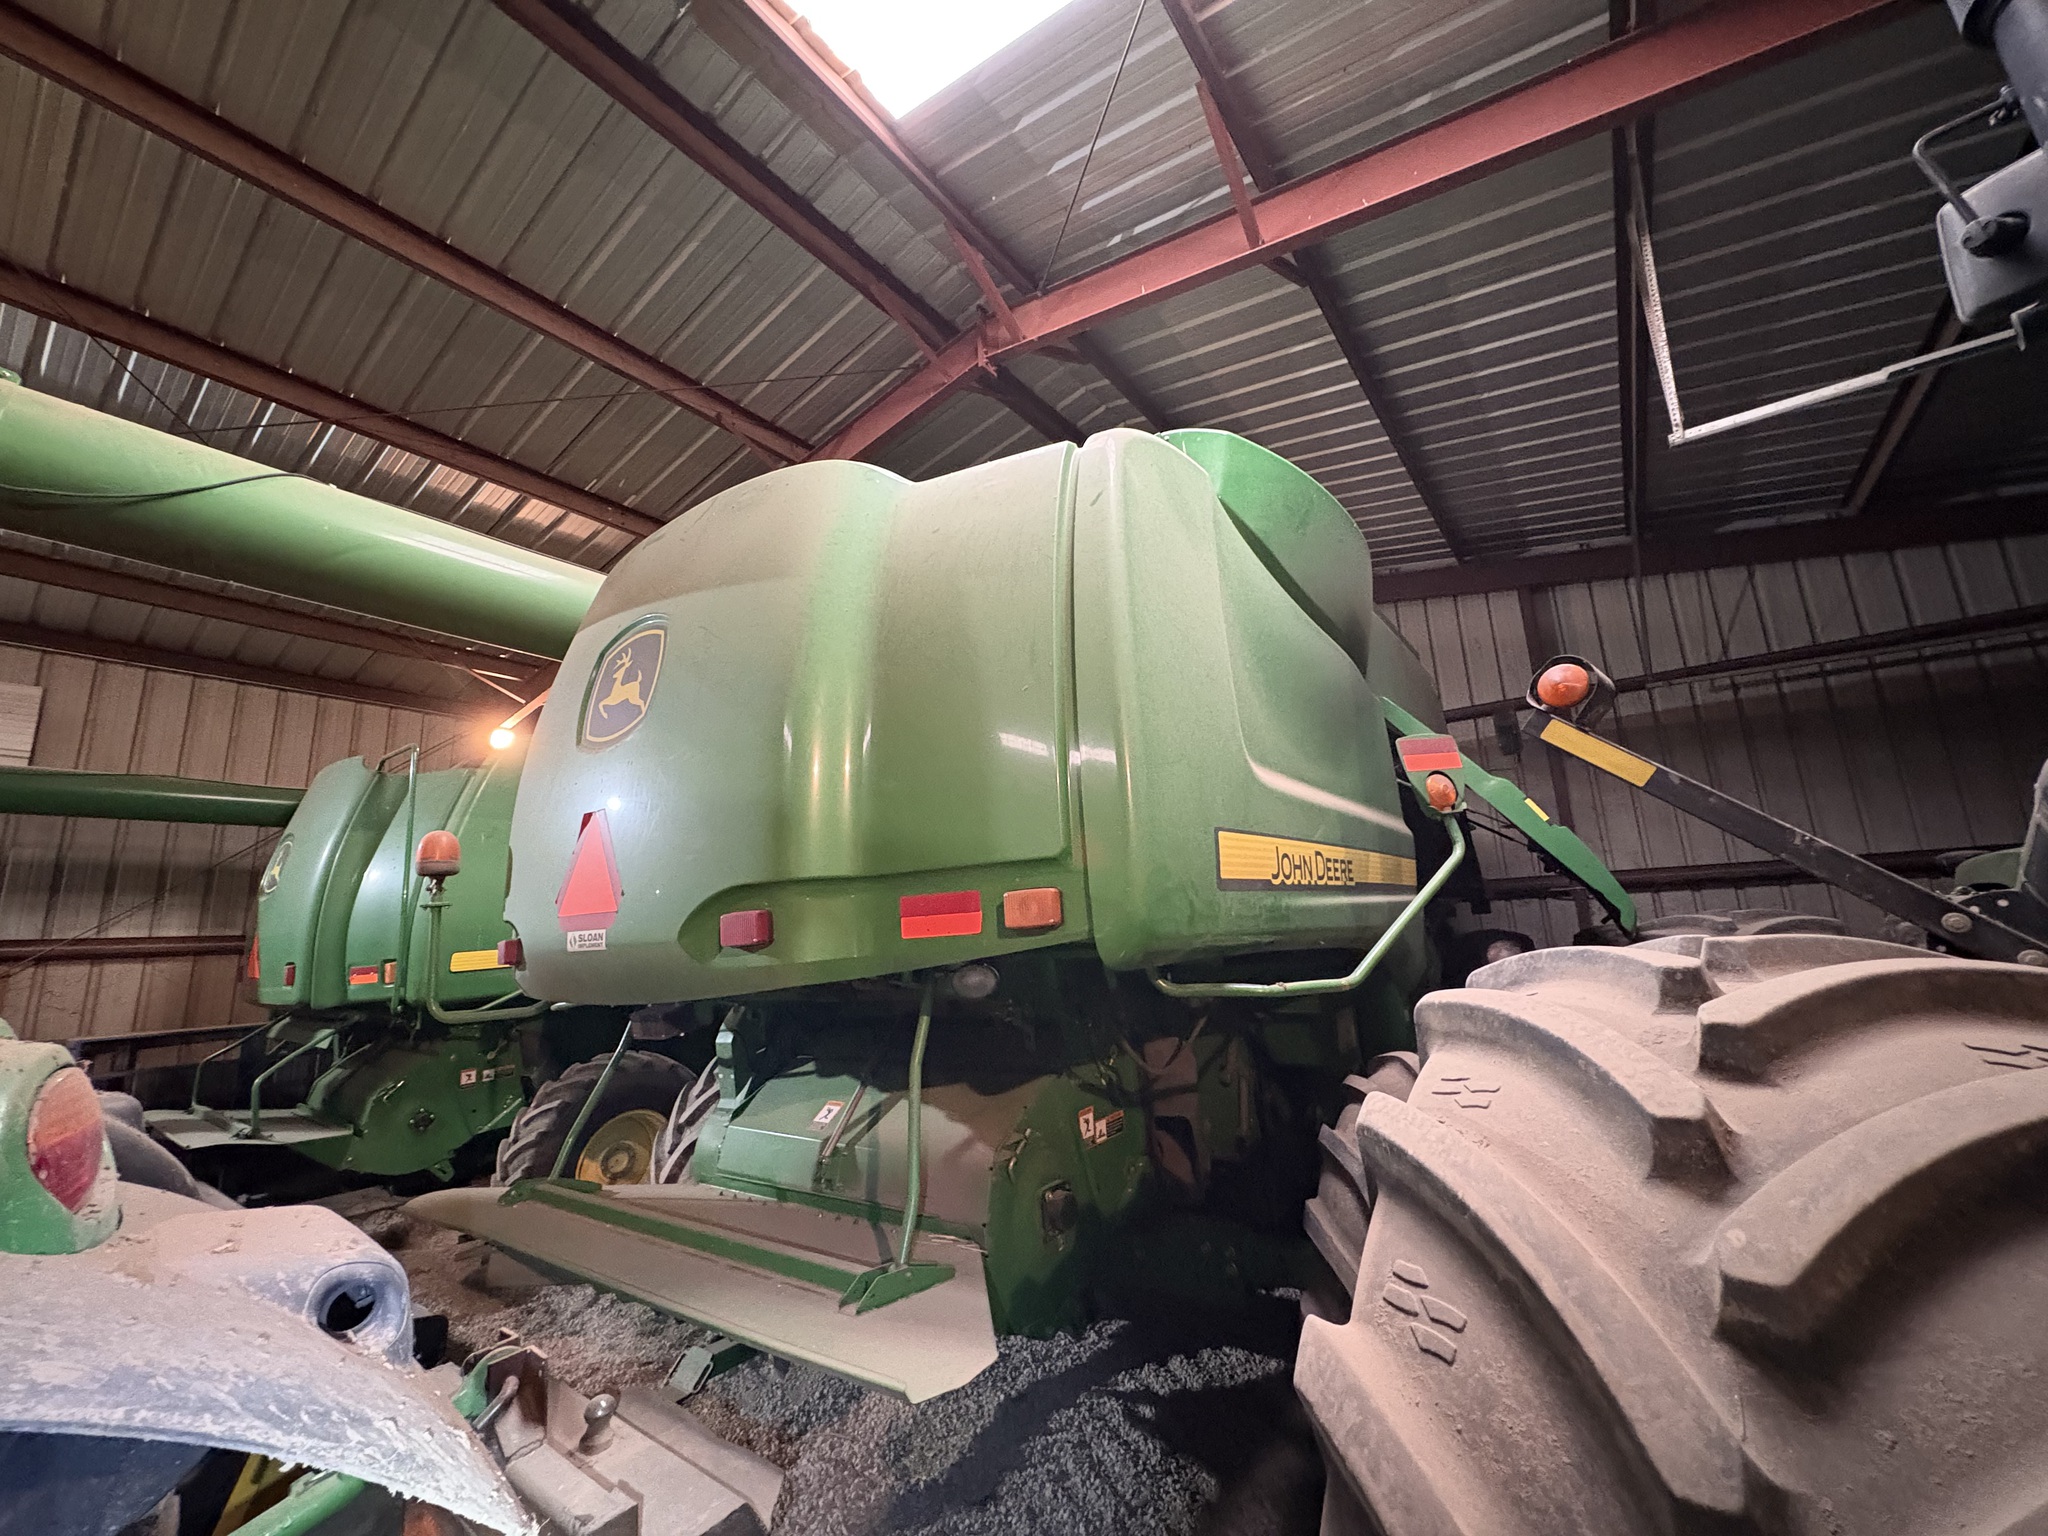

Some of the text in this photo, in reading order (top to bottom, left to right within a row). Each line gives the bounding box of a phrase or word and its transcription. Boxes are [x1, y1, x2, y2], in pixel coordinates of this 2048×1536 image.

[1271, 846, 1354, 882] JOHN DEERE
[578, 933, 604, 942] SLOAN
